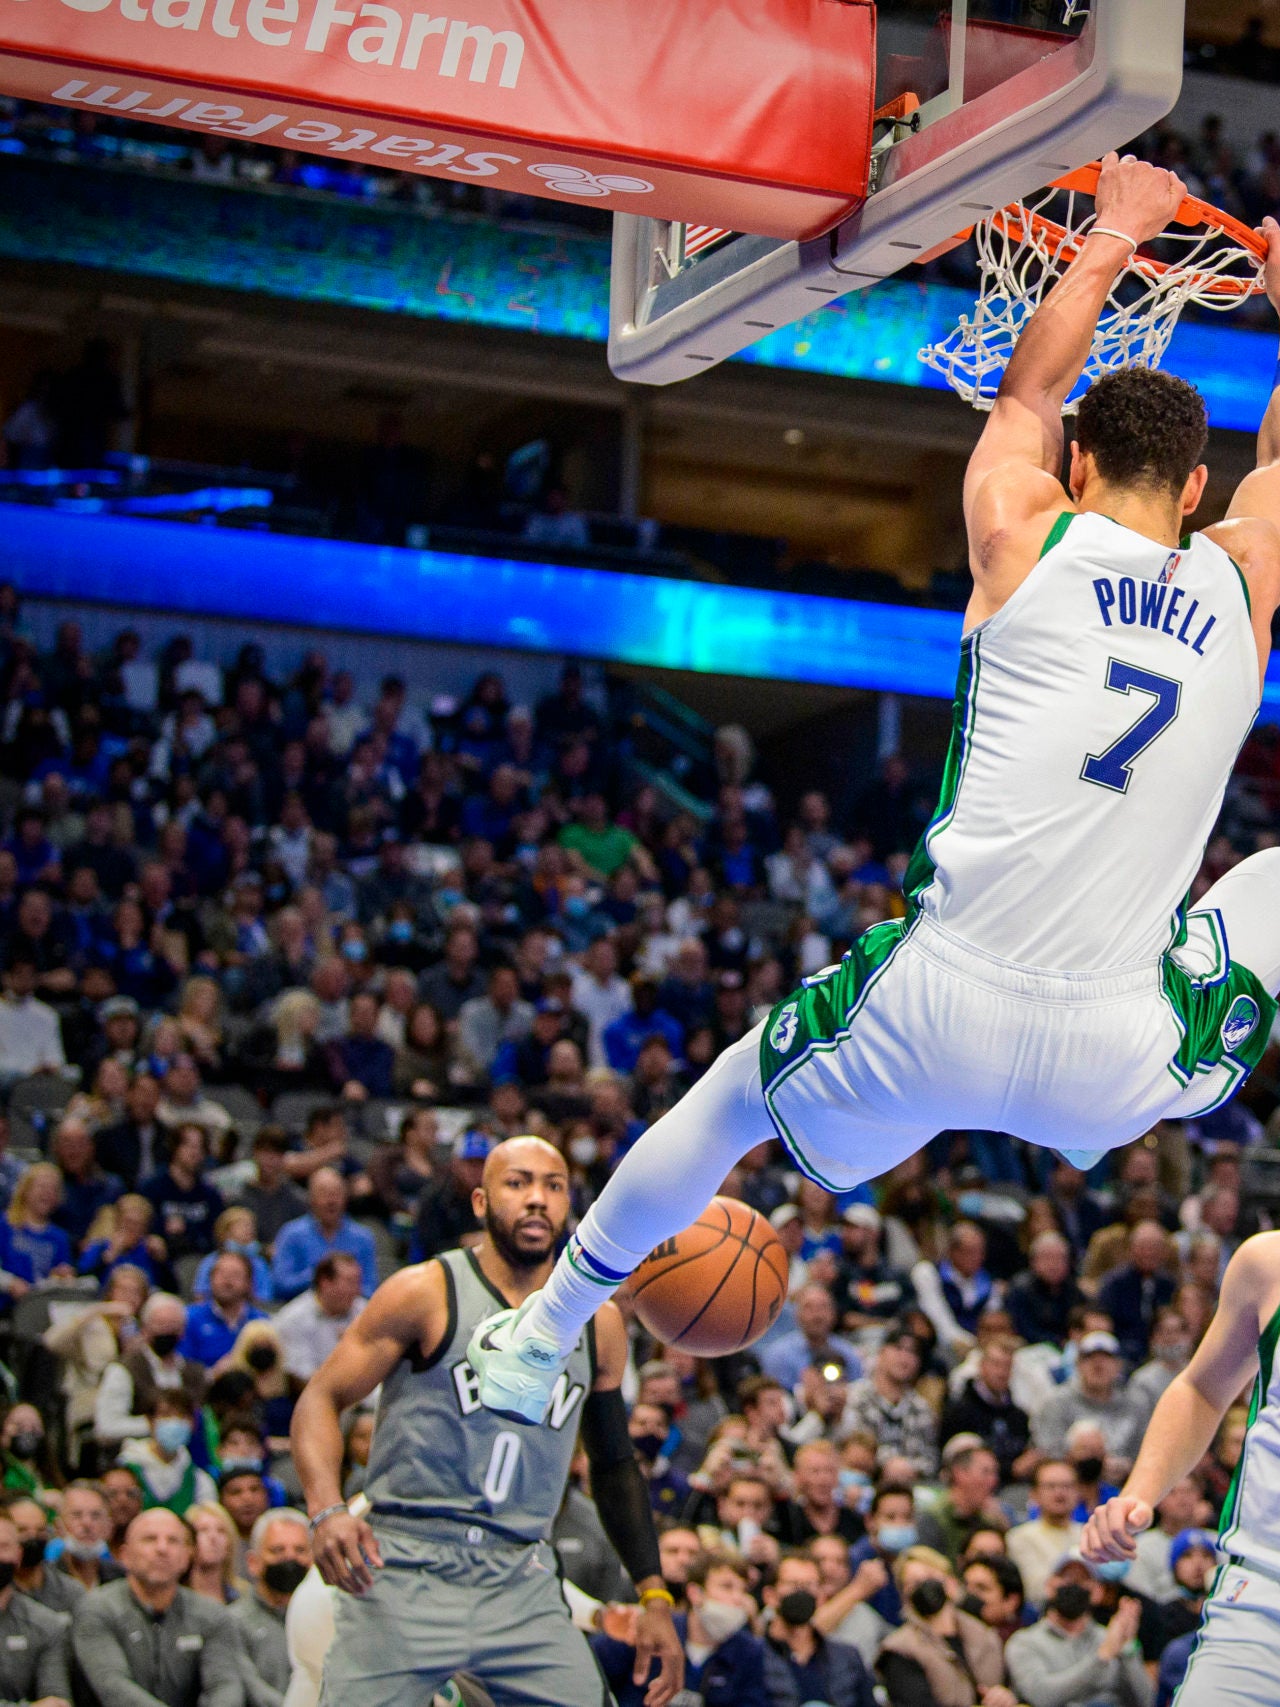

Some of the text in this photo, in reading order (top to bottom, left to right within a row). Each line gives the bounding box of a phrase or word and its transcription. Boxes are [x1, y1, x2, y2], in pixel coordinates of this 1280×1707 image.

[1092, 577, 1217, 656] POWELL
[1079, 656, 1183, 794] 7
[484, 1431, 521, 1504] 0
